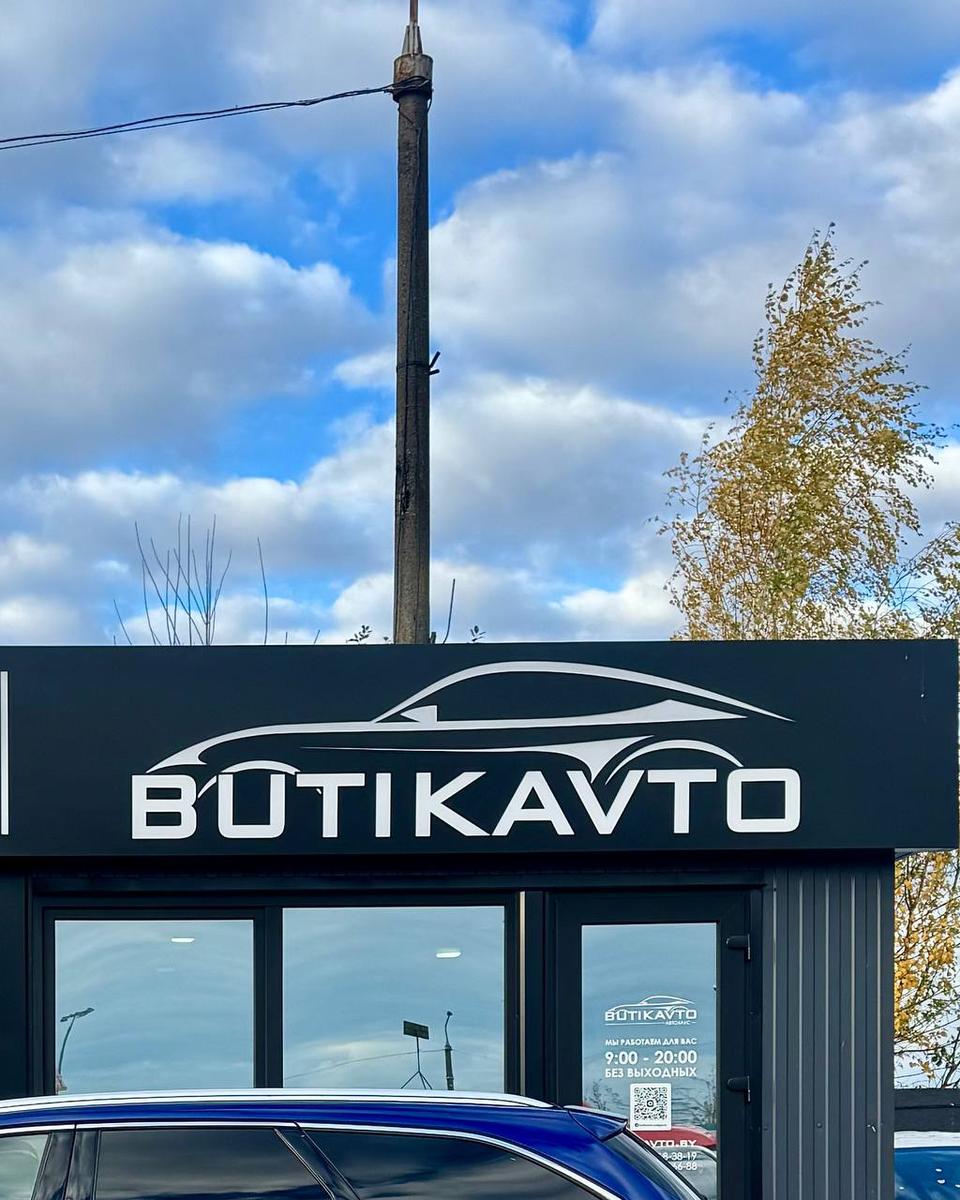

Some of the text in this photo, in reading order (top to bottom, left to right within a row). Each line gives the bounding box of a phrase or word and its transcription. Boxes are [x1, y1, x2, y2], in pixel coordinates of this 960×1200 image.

[131, 766, 802, 840] BUTIKAVTO
[604, 1010, 697, 1021] BUTIKAVTO
[662, 1038, 679, 1046] ДЛЯ
[605, 1051, 638, 1065] 9:00
[654, 1050, 697, 1064] 20:00
[605, 1067, 697, 1078] БЕЗ ВЫХОДНЫХ
